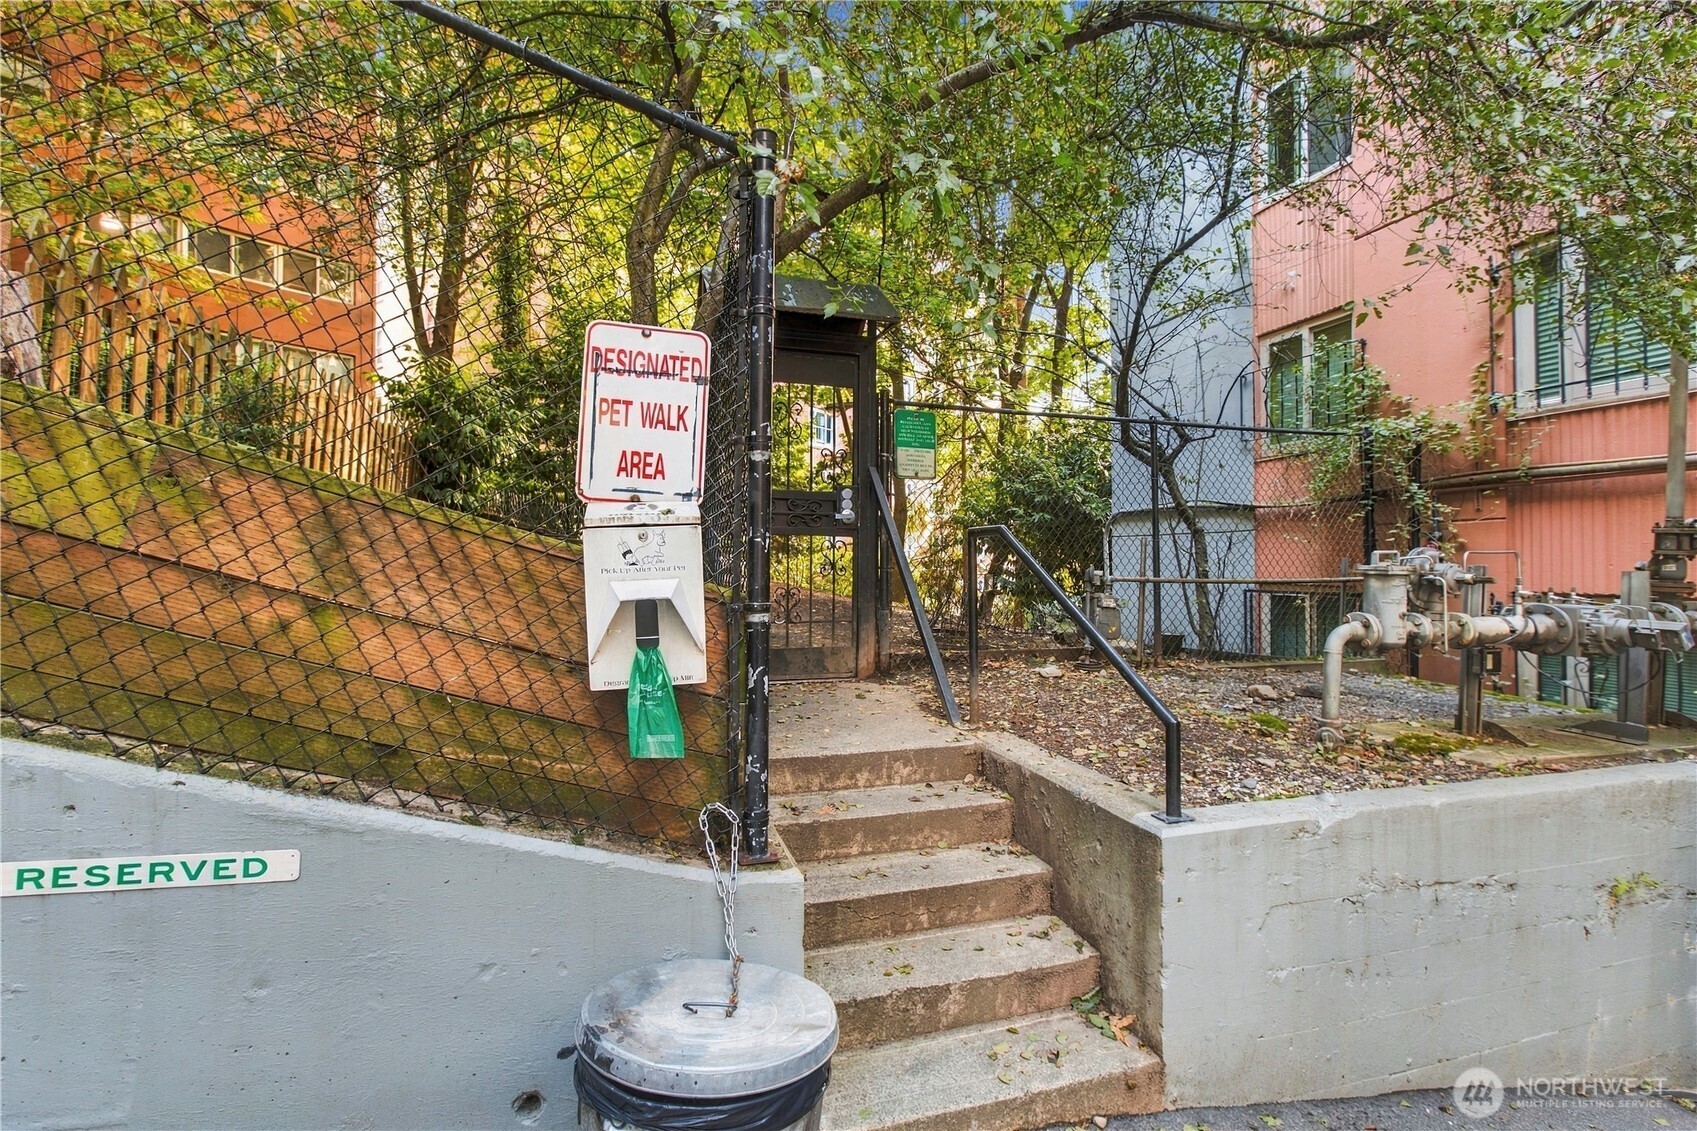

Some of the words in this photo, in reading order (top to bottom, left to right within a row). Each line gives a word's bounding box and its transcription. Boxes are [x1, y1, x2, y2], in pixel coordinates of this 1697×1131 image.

[590, 346, 703, 383] DESIGNATED
[598, 397, 633, 427] PET
[640, 401, 689, 432] WALK
[616, 450, 666, 480] AREA
[600, 567, 618, 575] Pick
[619, 566, 631, 575] Up
[633, 566, 652, 574] After
[653, 565, 672, 573] Your
[15, 857, 269, 890] RESERVED
